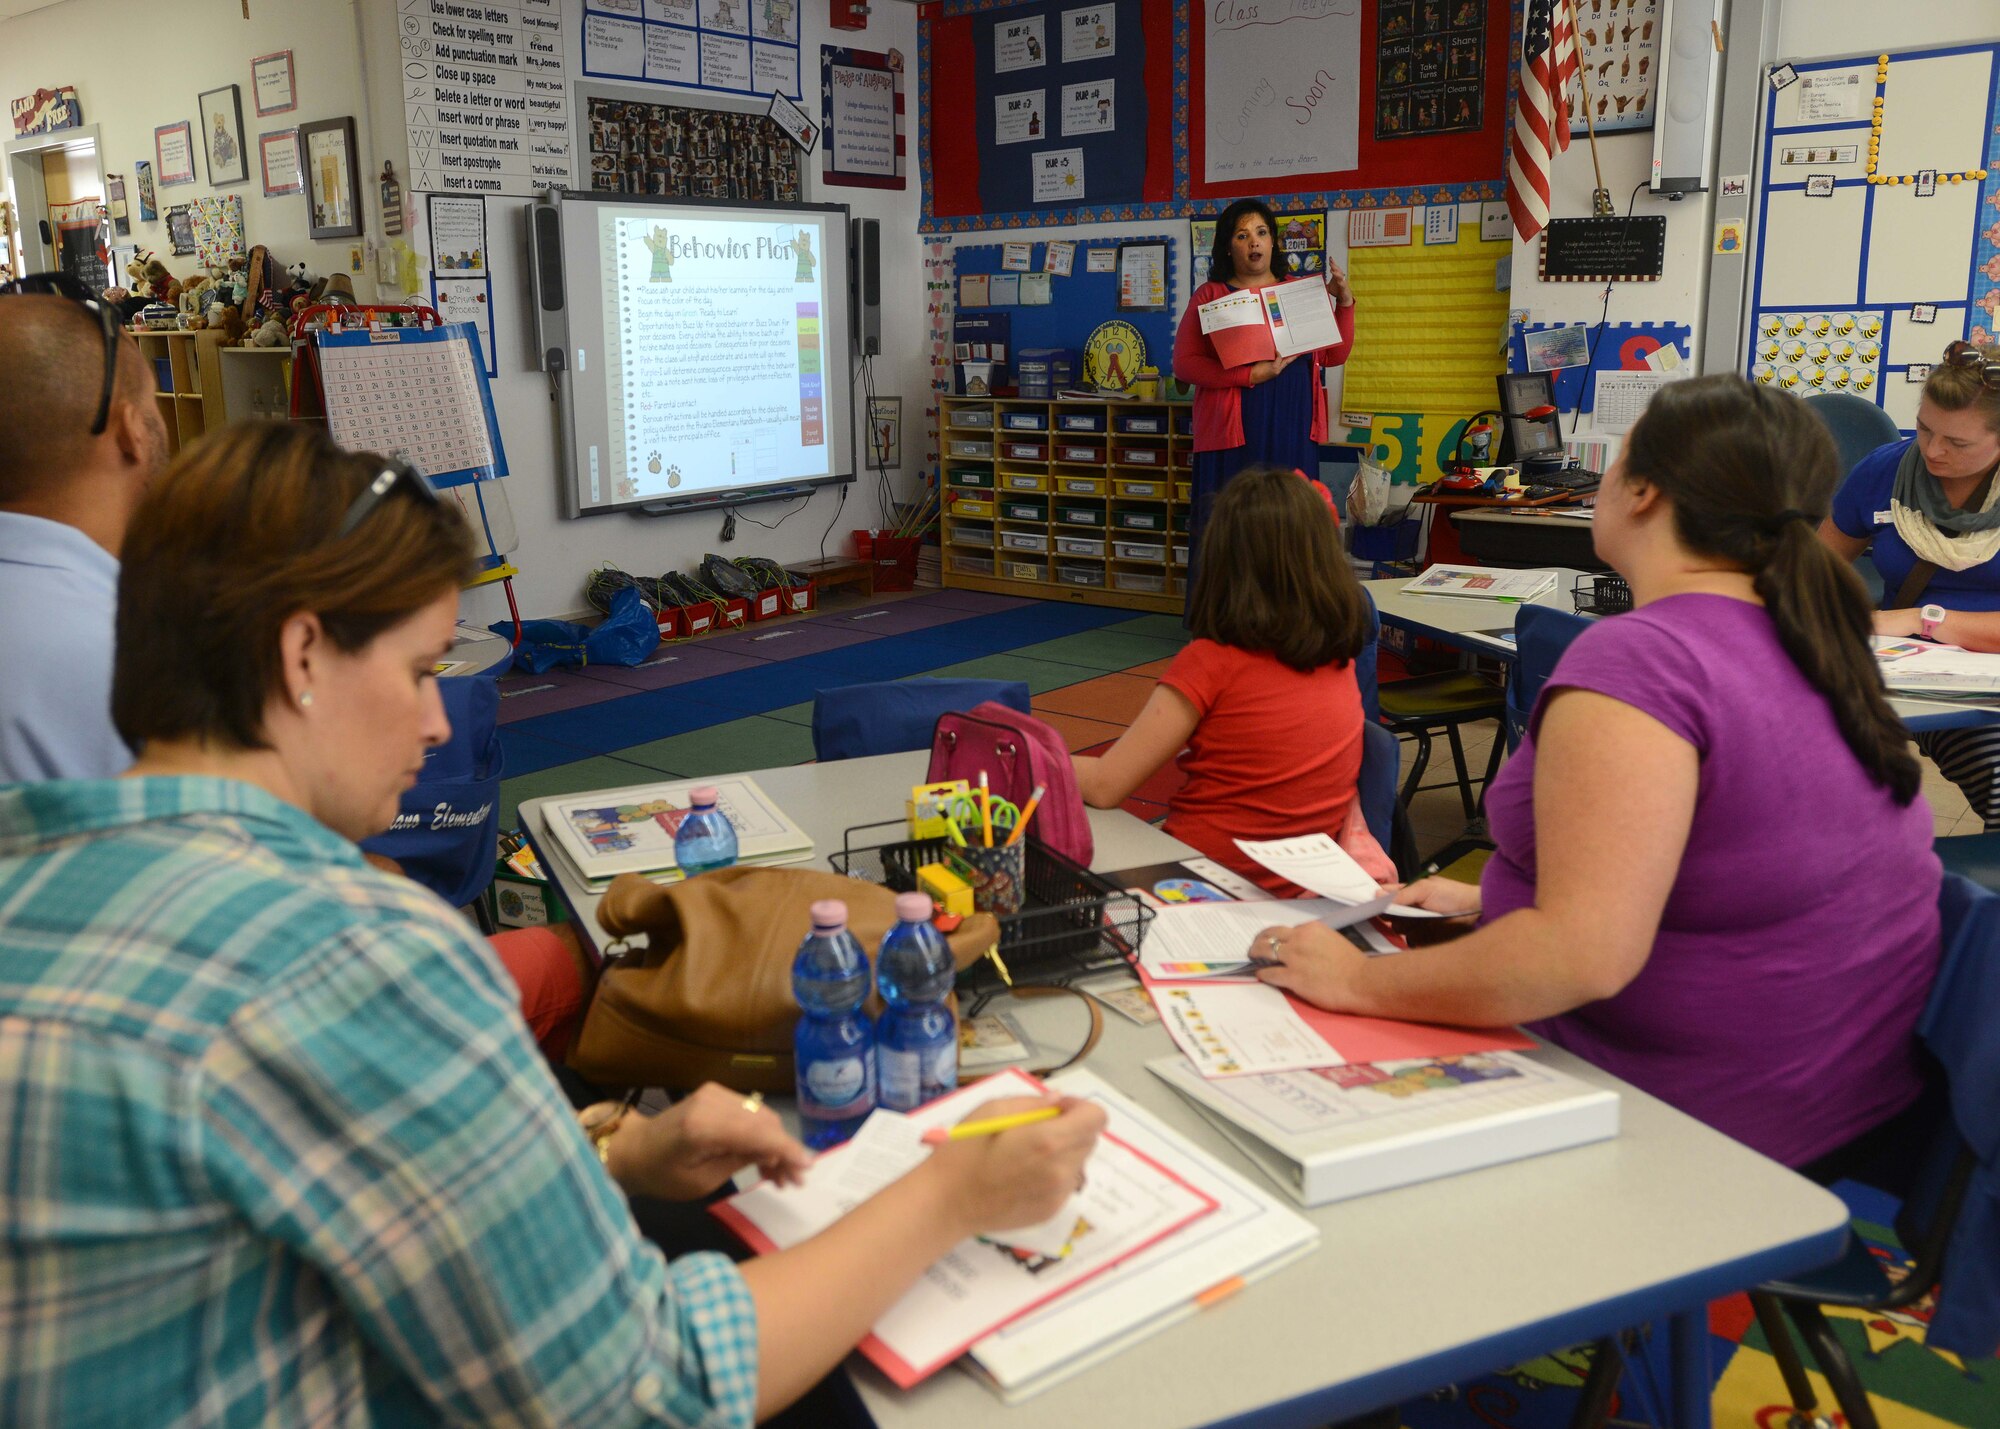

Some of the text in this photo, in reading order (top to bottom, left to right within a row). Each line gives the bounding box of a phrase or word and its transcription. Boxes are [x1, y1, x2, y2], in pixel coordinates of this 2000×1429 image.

[431, 0, 508, 24] Use lower case letters
[1215, 1, 1258, 24] Class
[432, 22, 513, 45] Check for spelling error
[1452, 36, 1477, 46] Share
[436, 44, 518, 66] Add punctuation mark
[530, 42, 553, 52] frend
[1394, 45, 1410, 54] Kind
[436, 65, 496, 86] Close up space
[834, 70, 891, 91] Pledge of Allegiance
[436, 88, 525, 110] Delete a letter or word
[1286, 70, 1336, 124] Soon
[13, 96, 35, 118] LAND
[1216, 78, 1276, 146] Coming
[46, 105, 68, 132] FREE
[438, 108, 520, 130] Insert word or phrase
[440, 131, 518, 150] Insert quotation mark
[442, 153, 501, 171] Insert apostrophe
[444, 174, 501, 190] Insert a comma
[1723, 180, 1744, 195] bed
[670, 235, 794, 260] Behavior Plan
[1286, 238, 1307, 250] 2014
[449, 306, 480, 314] Process
[1112, 327, 1120, 335] 12
[1094, 340, 1100, 349] 10
[1133, 340, 1137, 349] 2
[1089, 353, 1094, 361] 9
[1136, 353, 1140, 362] 3
[1092, 367, 1096, 375] 8
[1110, 380, 1115, 388] 6
[1370, 416, 1403, 474] 5
